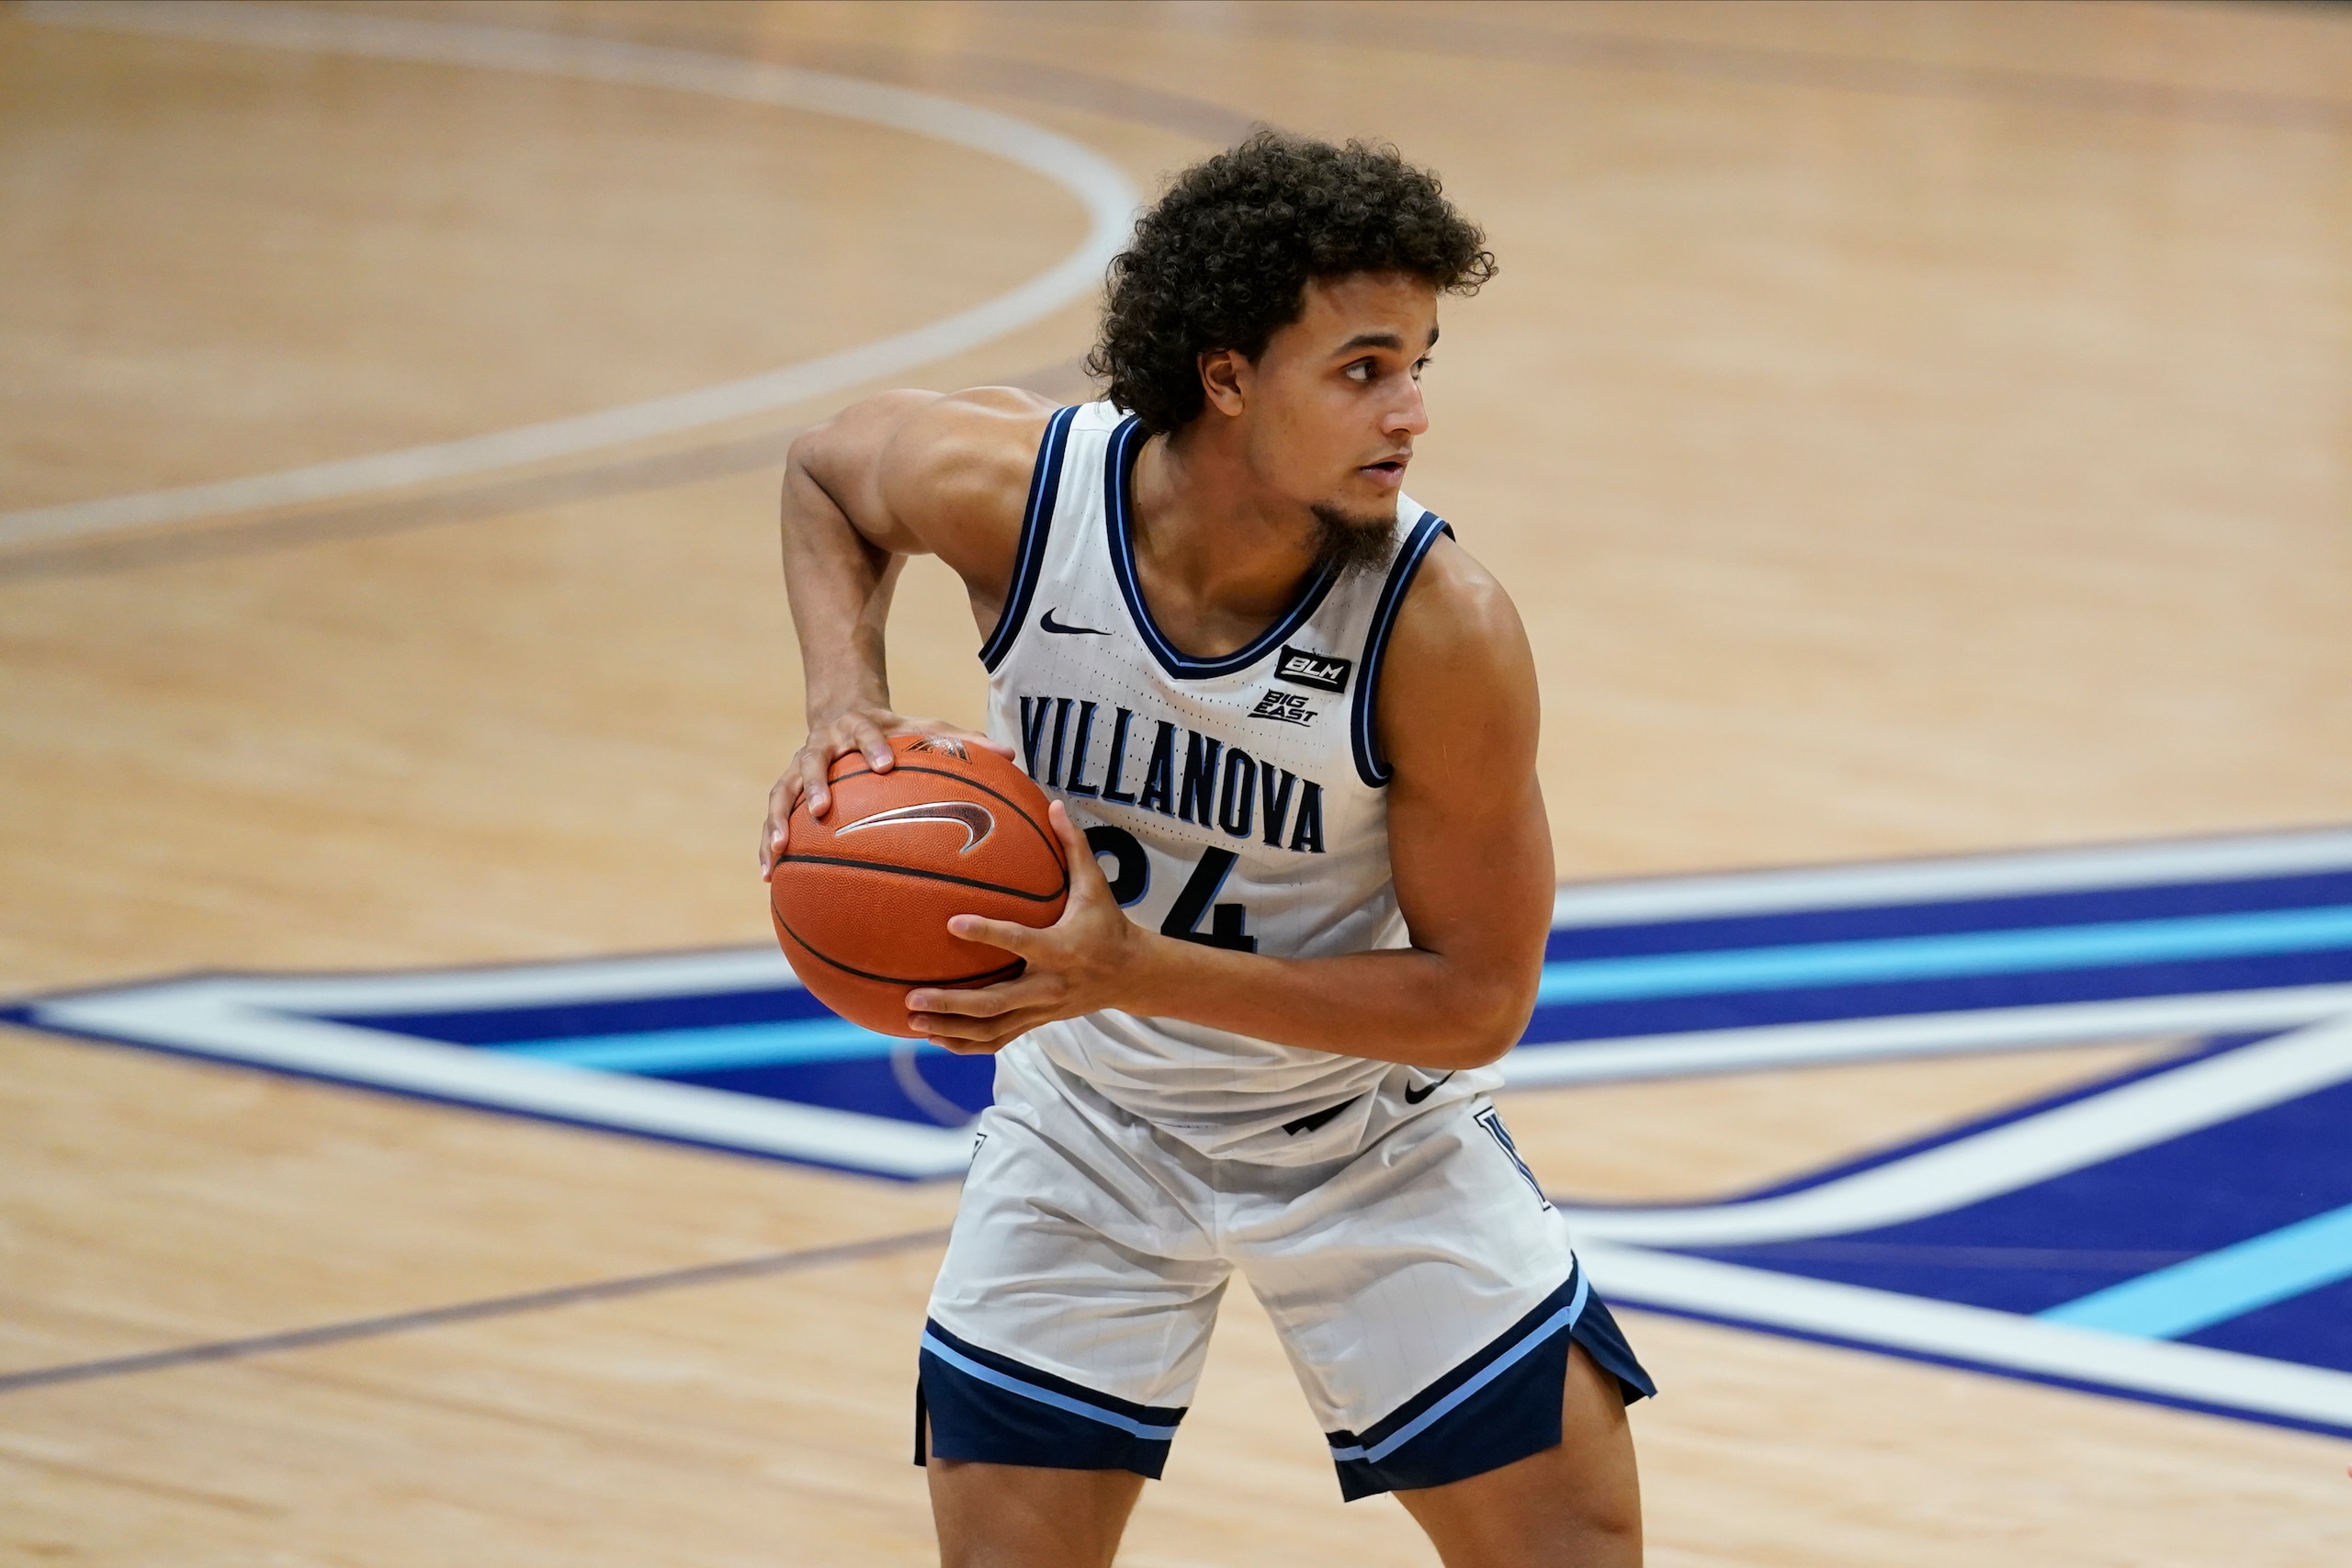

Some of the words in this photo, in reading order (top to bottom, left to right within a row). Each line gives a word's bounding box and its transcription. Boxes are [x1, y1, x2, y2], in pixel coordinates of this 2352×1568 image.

[1284, 656, 1344, 680] BLM
[1262, 689, 1309, 708] BIG
[1253, 702, 1318, 722] EAST
[1019, 695, 1326, 854] VILLANOVA
